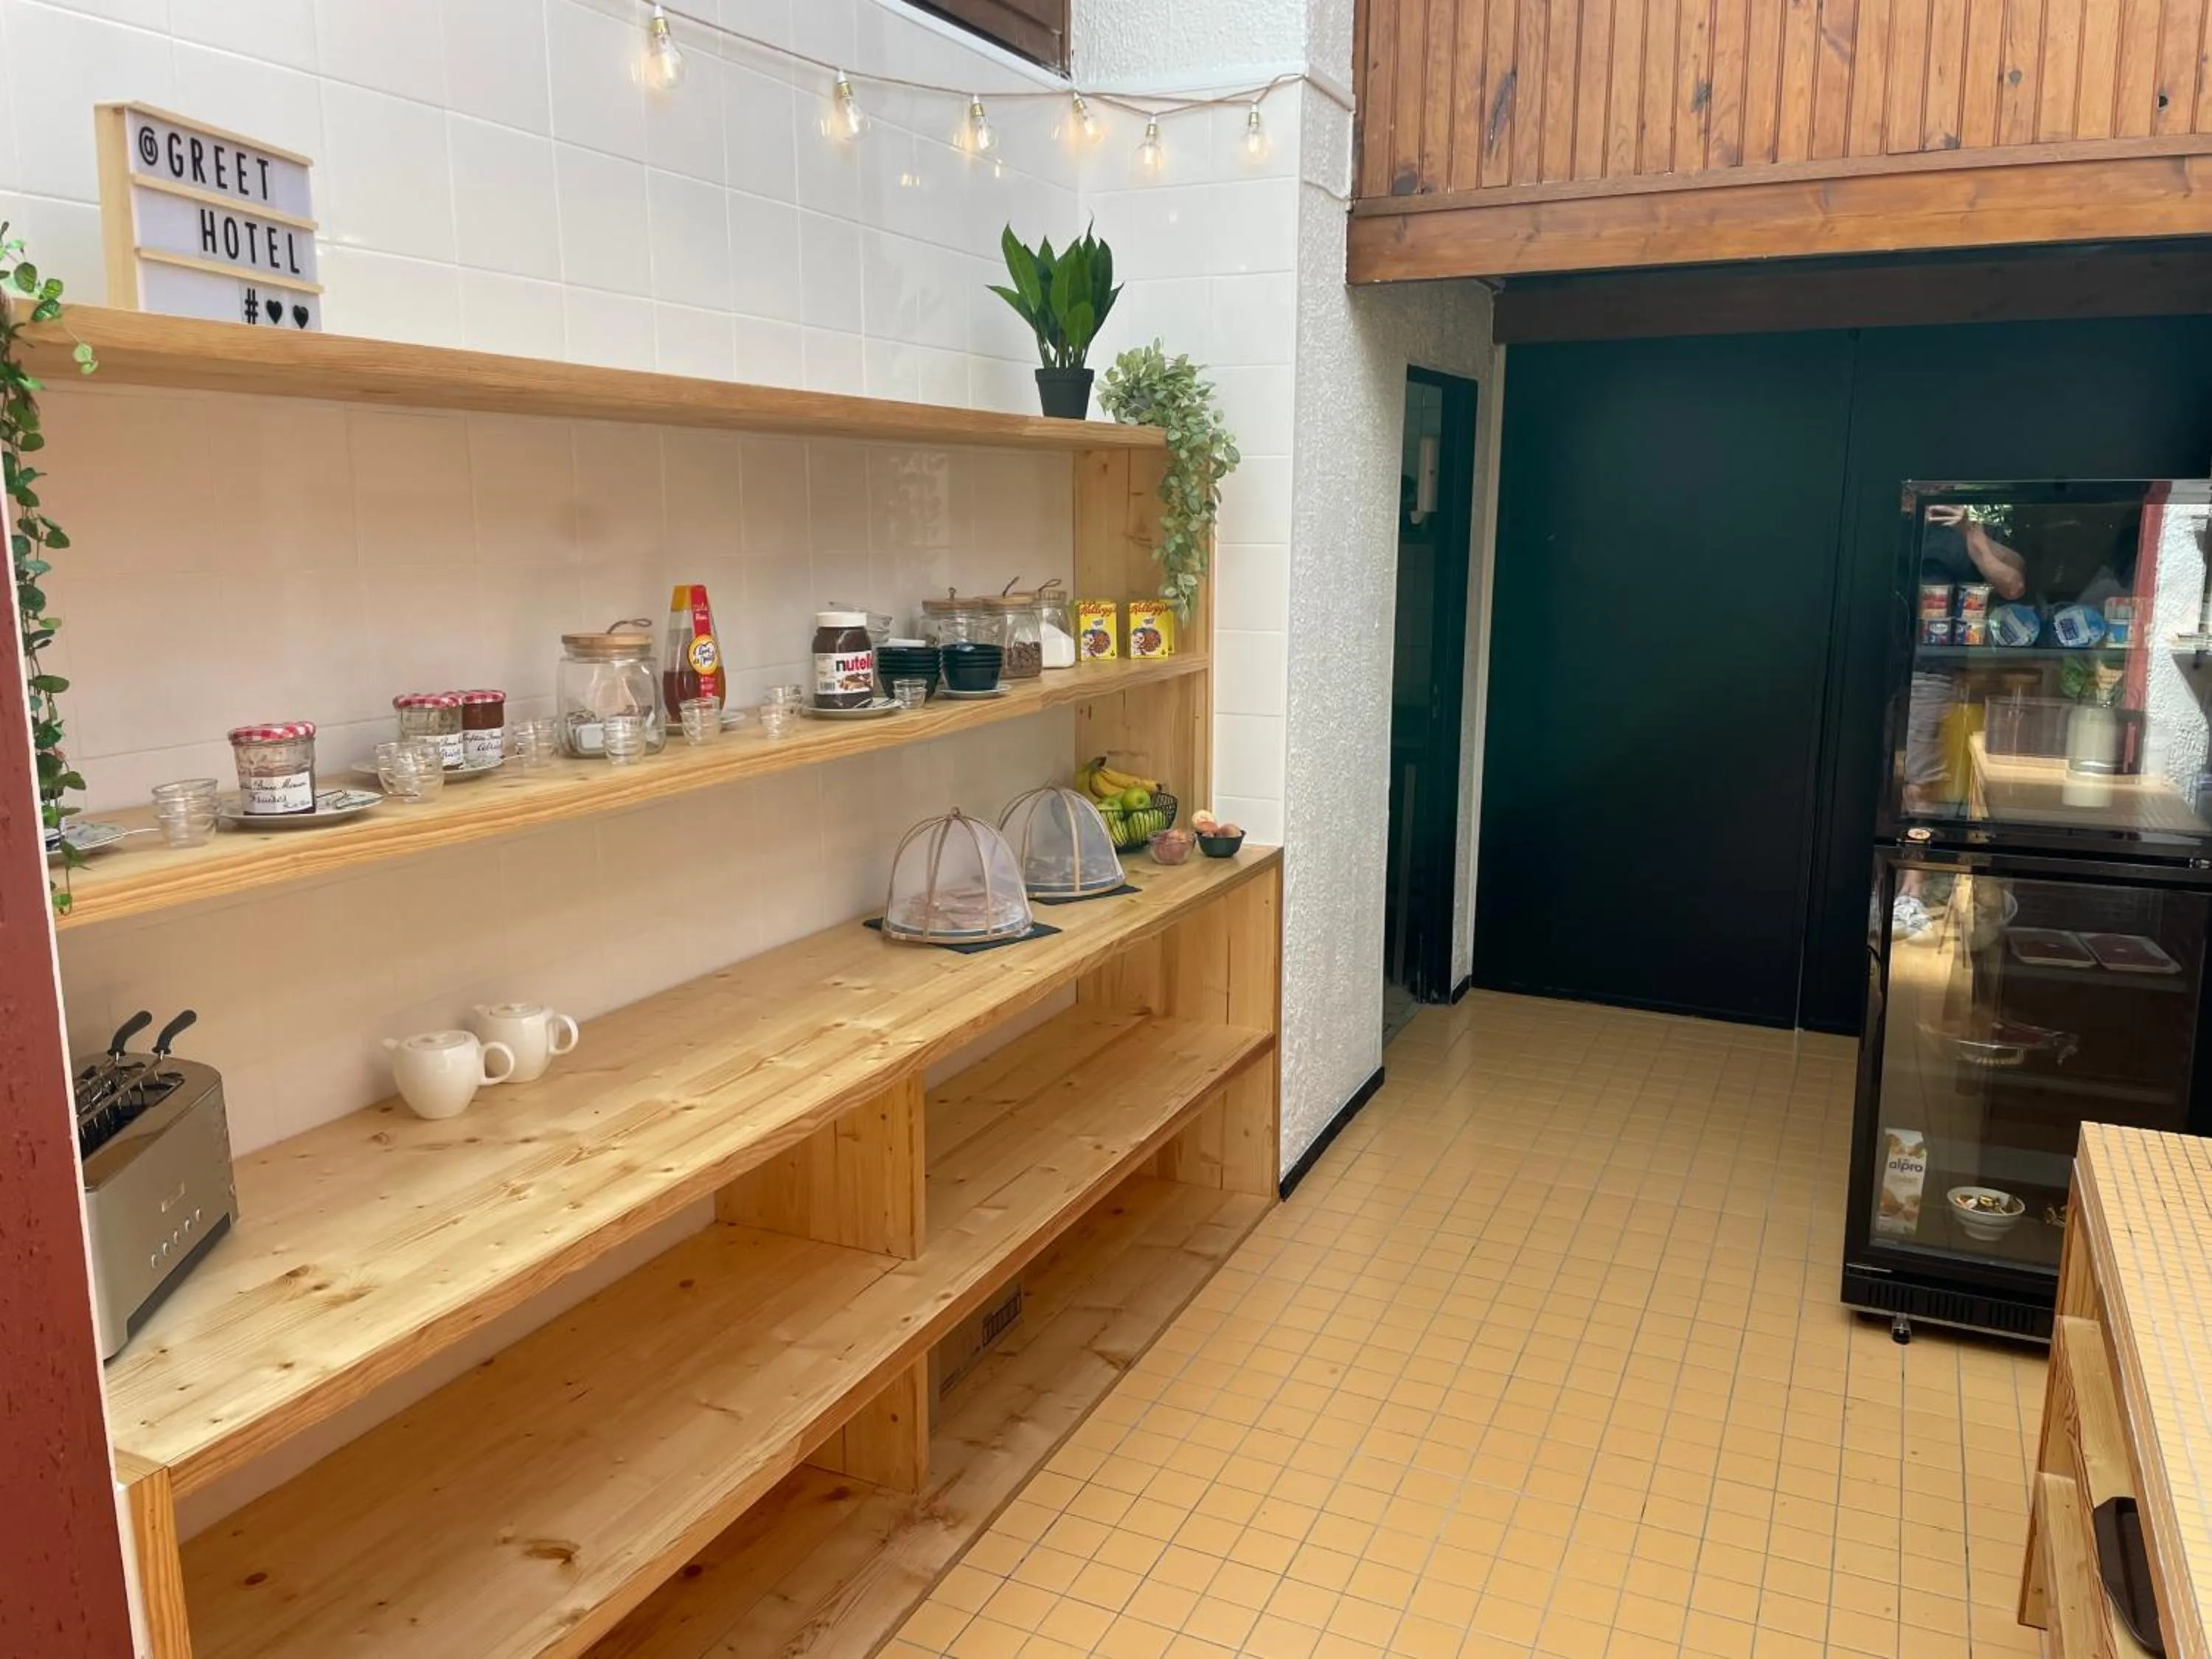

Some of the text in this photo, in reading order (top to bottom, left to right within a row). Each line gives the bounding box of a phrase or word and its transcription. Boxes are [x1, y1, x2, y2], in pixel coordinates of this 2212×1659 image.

[139, 125, 269, 201] @GREET
[200, 208, 300, 274] HOTEL
[1888, 1158, 1924, 1173] alpro
